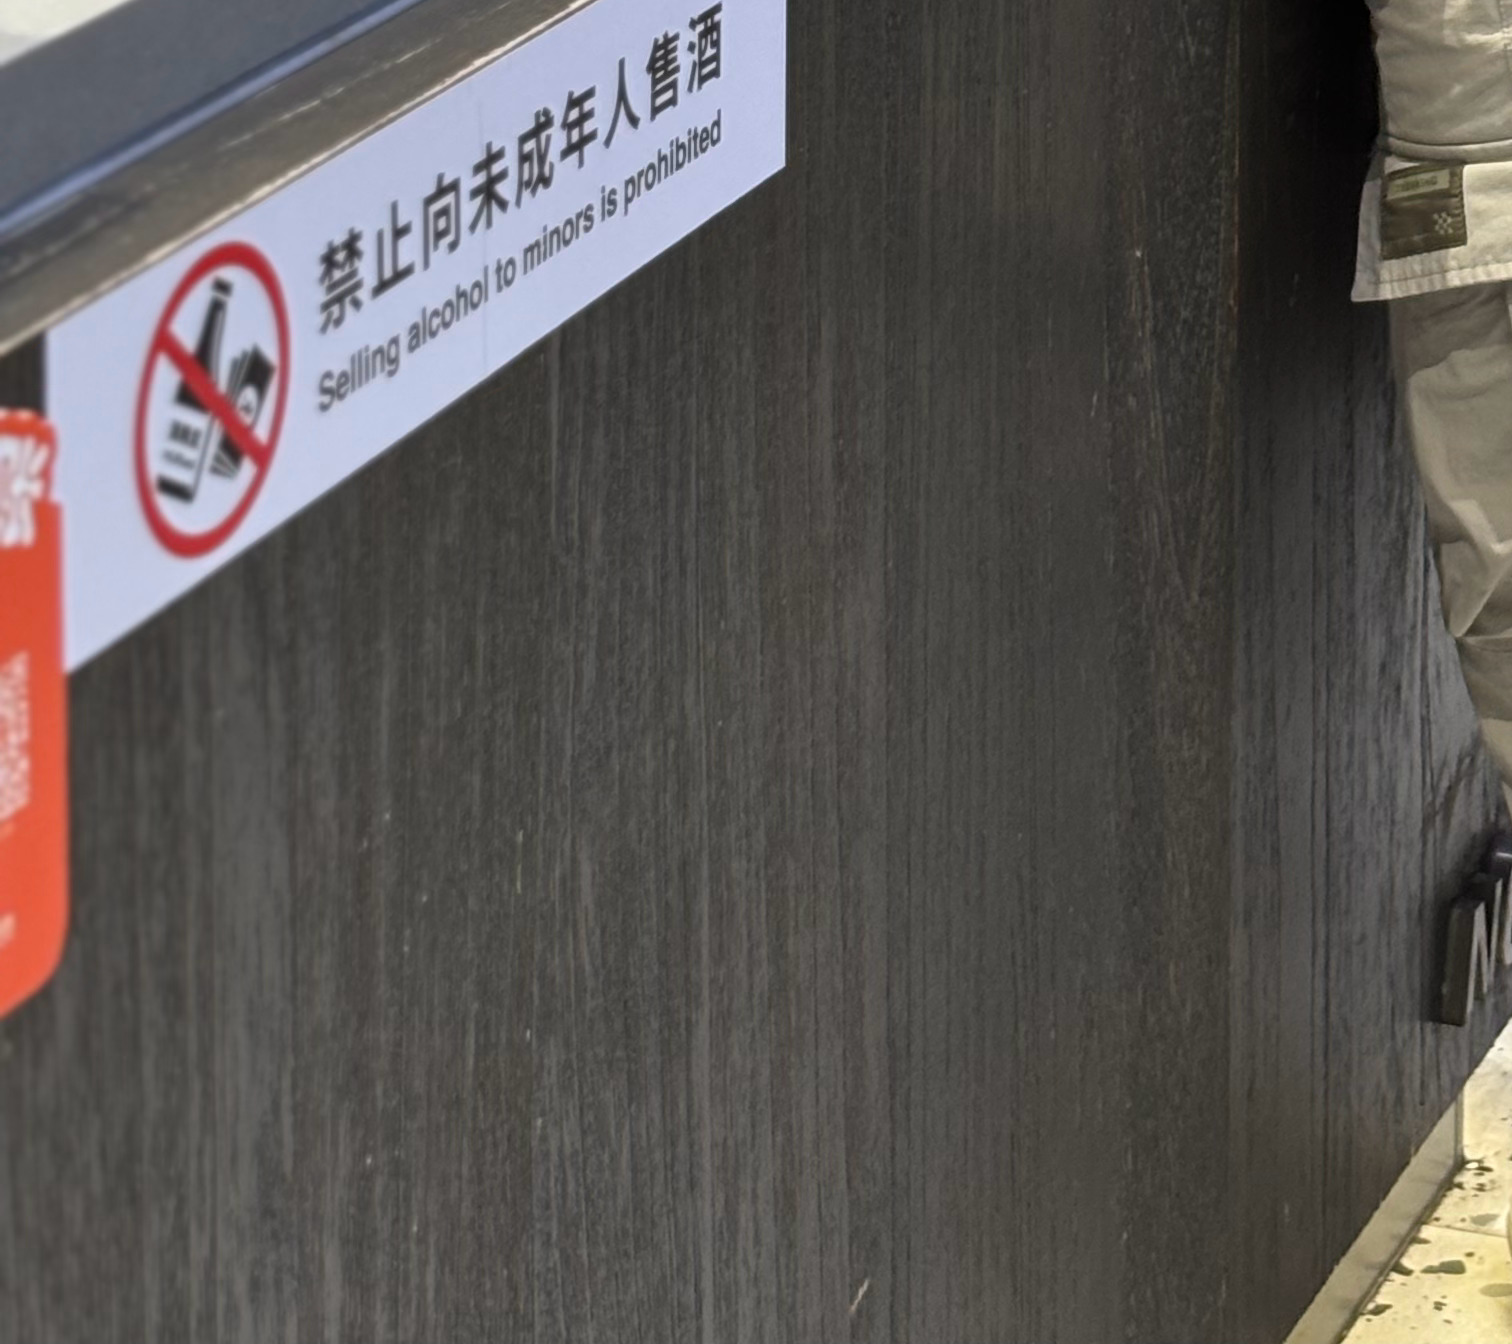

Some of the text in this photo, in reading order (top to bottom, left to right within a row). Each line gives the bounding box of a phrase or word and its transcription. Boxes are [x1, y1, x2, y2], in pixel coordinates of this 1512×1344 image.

[318, 0, 724, 335] 禁止向未成年人售酒
[318, 109, 722, 413] Selling alcohol to minors is prohibited
